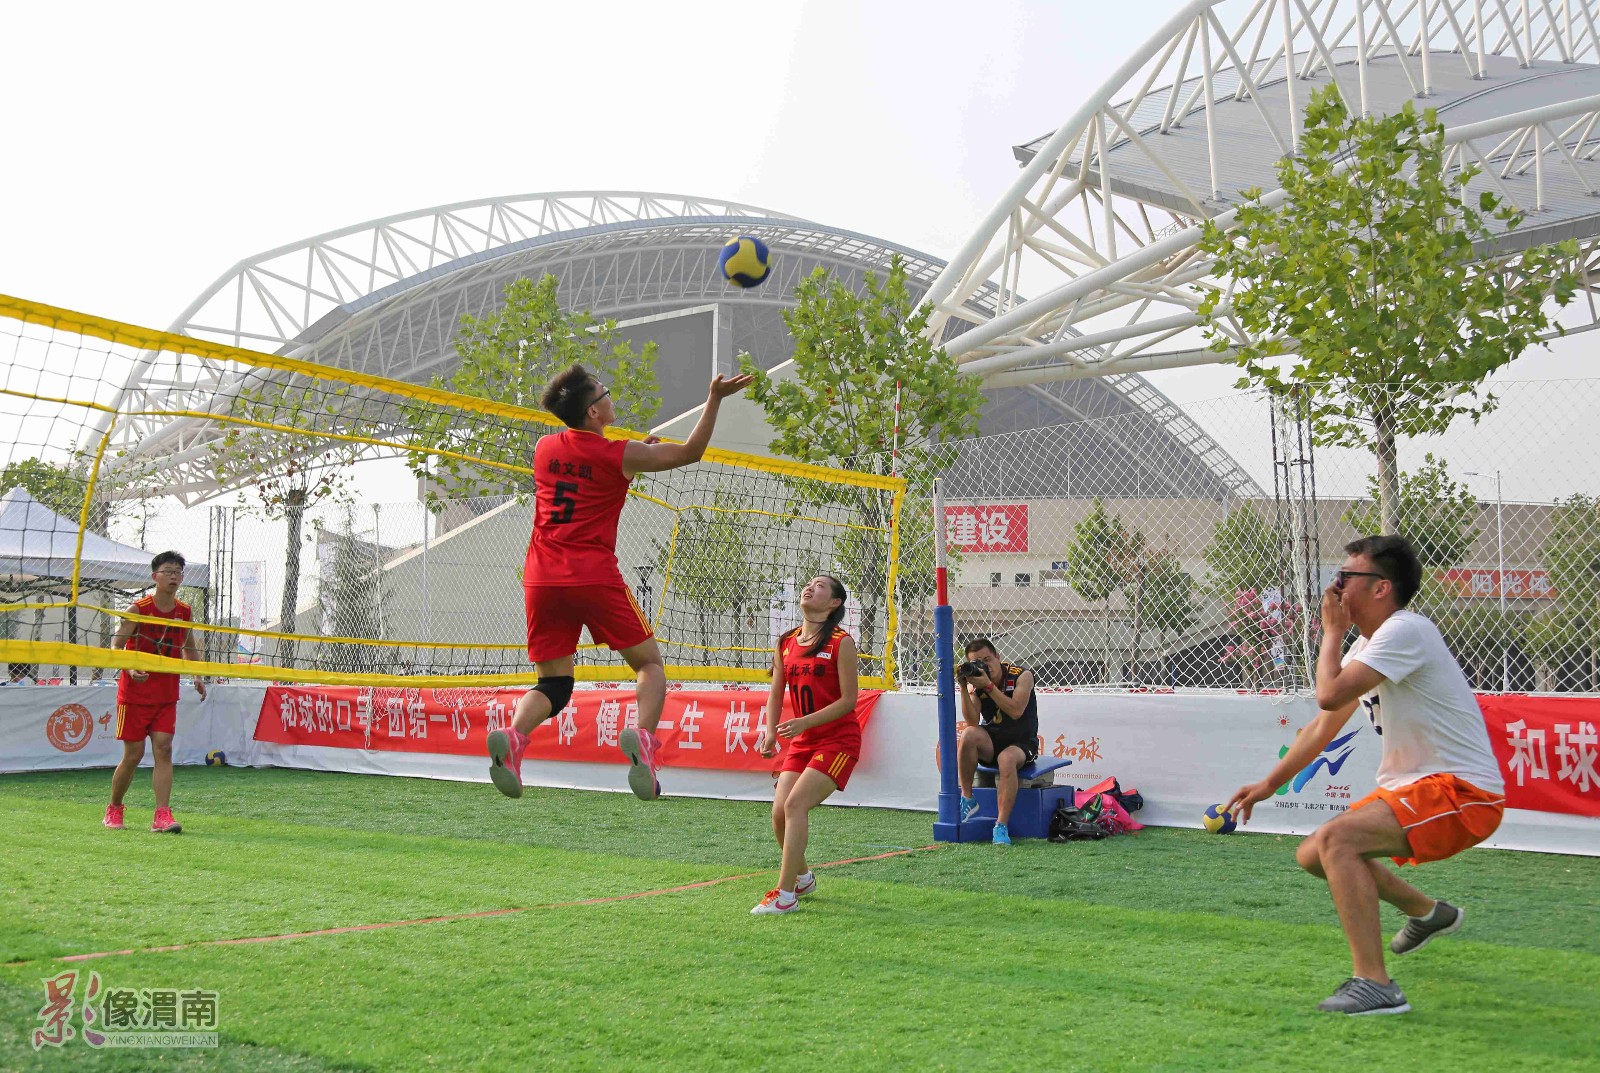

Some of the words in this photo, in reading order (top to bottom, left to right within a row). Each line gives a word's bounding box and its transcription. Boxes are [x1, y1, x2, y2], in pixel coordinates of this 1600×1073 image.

[551, 481, 578, 524] 5
[946, 512, 1010, 545] 建设
[1471, 573, 1549, 594] 阳光体
[793, 684, 815, 717] 10
[485, 699, 578, 746] 和体
[1037, 734, 1103, 763] 和球
[1505, 718, 1600, 793] 和球
